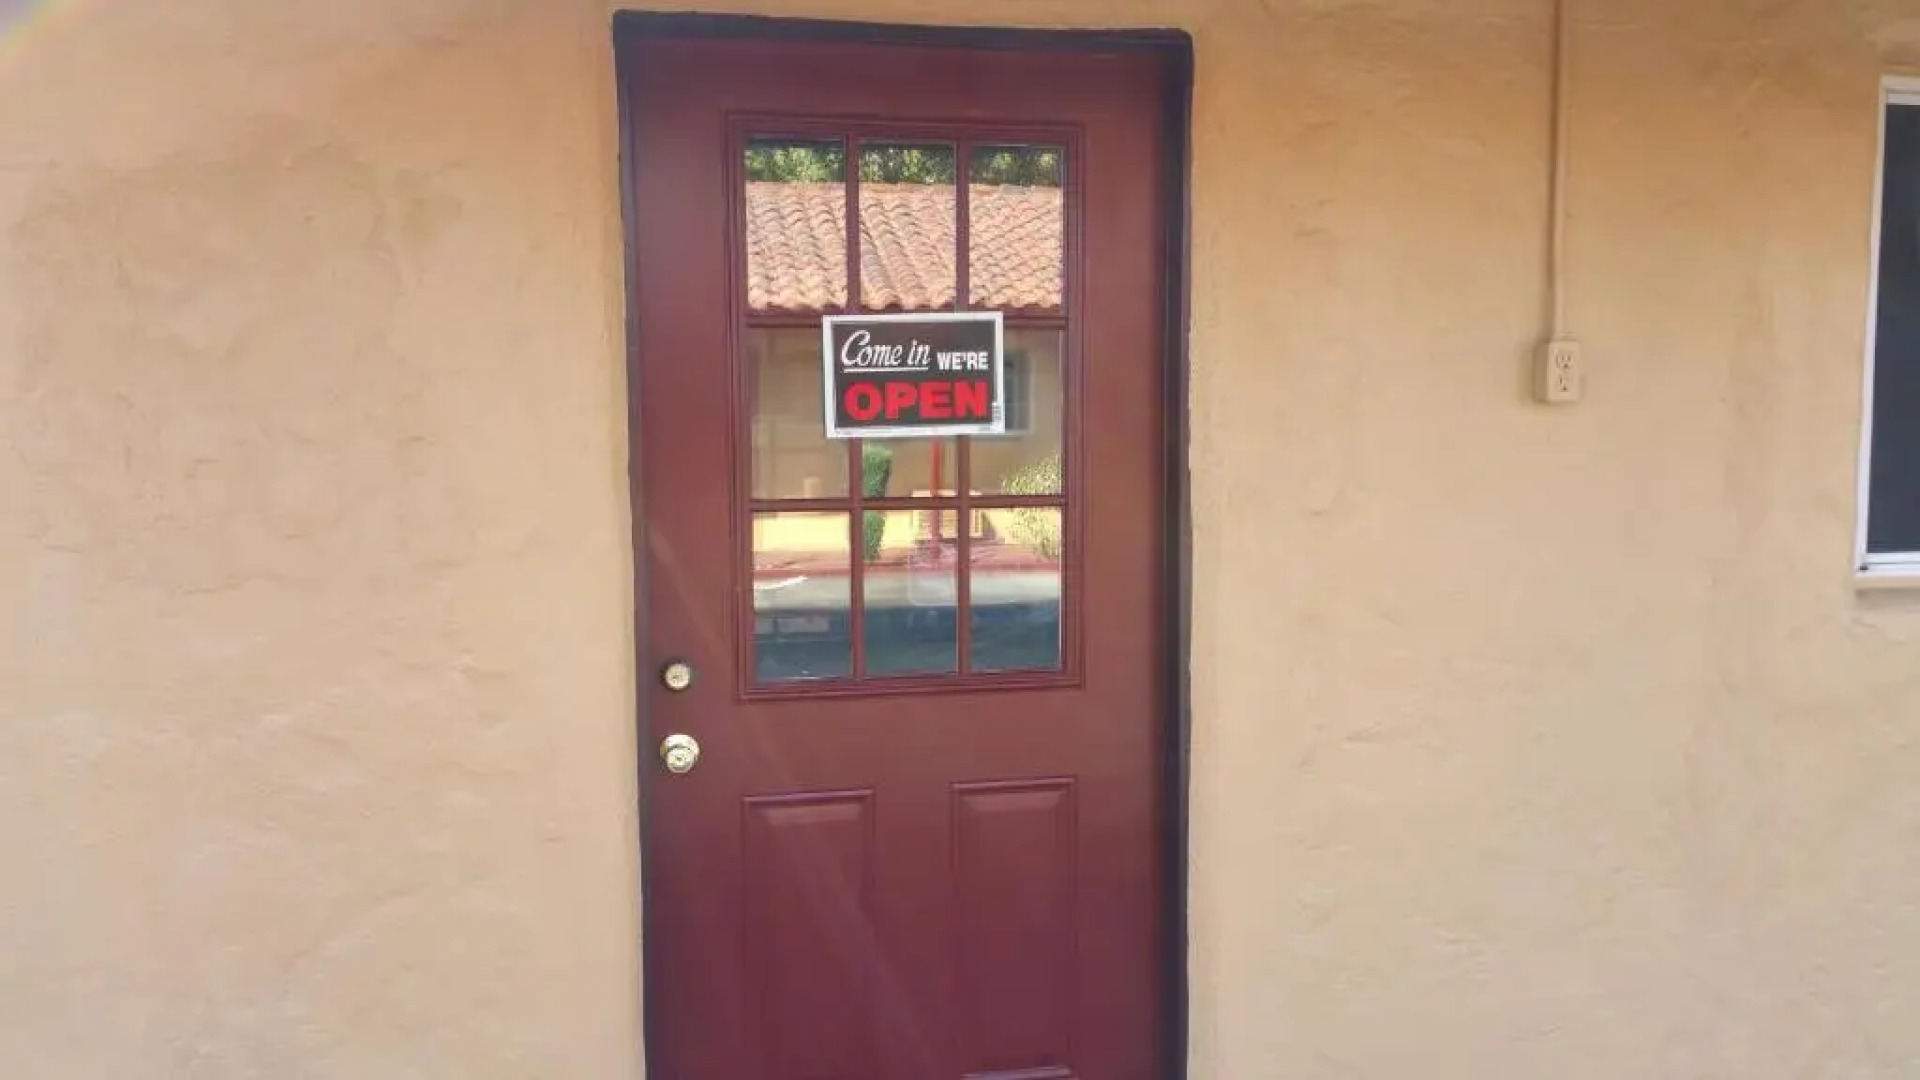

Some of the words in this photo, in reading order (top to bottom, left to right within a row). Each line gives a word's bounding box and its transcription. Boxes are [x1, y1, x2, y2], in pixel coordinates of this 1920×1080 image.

[841, 330, 902, 367] Come
[906, 339, 931, 366] in
[937, 351, 989, 370] WE'RE
[844, 380, 988, 421] OPEN
